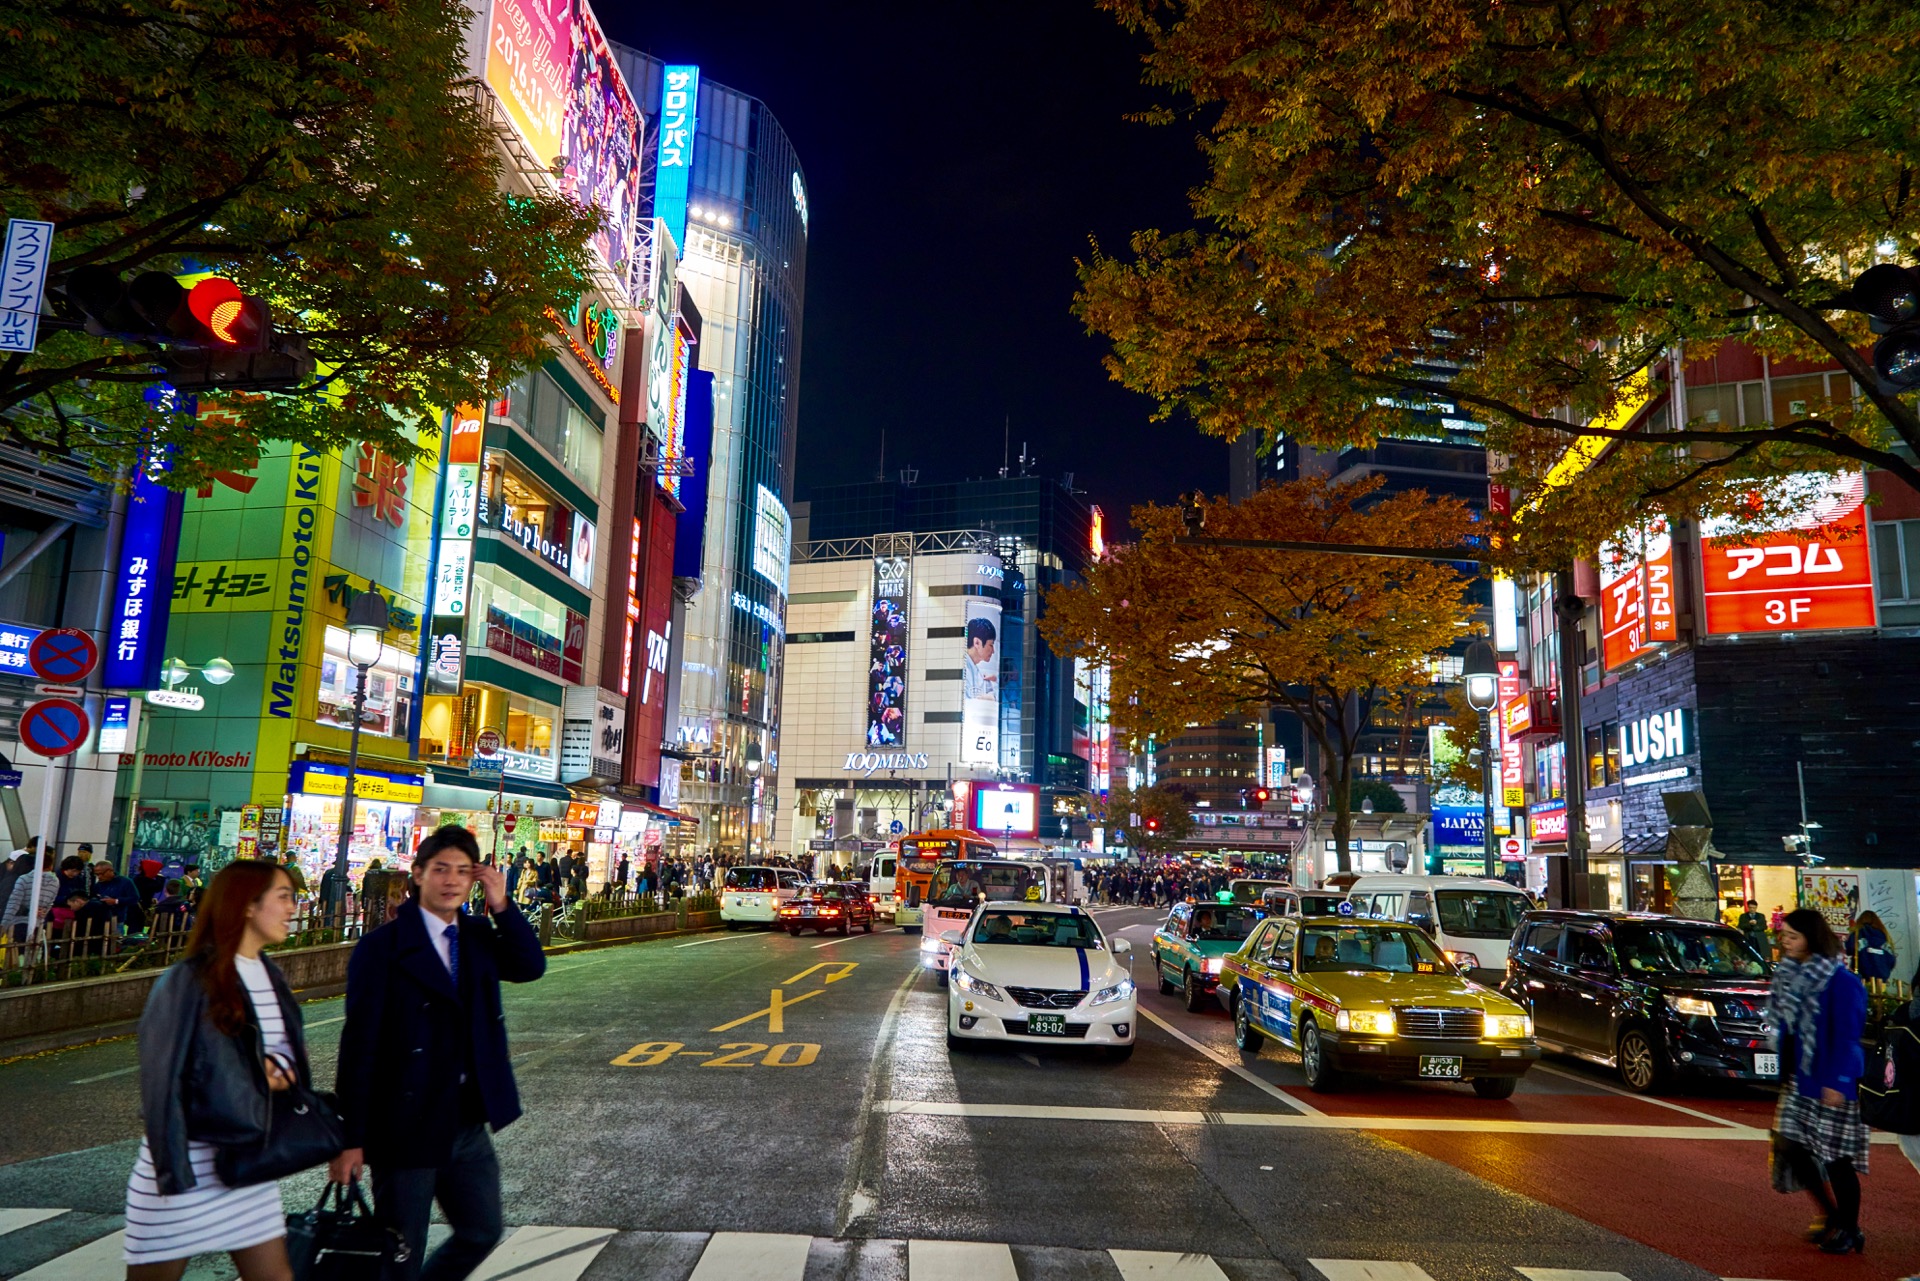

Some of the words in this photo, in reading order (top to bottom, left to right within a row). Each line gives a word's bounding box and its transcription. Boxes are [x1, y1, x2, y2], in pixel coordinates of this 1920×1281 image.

[495, 23, 557, 136] 2016.11.16
[661, 72, 689, 167] サロンパス
[1, 226, 40, 346] スクランブル式
[453, 419, 481, 434] JTB
[461, 480, 473, 517] フルーツ
[502, 504, 568, 568] Euphoria
[879, 562, 905, 579] EXO
[1726, 542, 1844, 580] アコム
[440, 564, 452, 602] フルーツ
[879, 583, 904, 597] XMAS
[1649, 565, 1672, 615] アコム
[117, 557, 148, 661] みずほ銀行
[269, 508, 315, 719] Matsumoto
[1764, 597, 1812, 624] 3F
[1654, 621, 1670, 630] 3F
[0, 632, 30, 649] 銀行
[436, 634, 461, 675] HUB
[479, 738, 498, 750] 消火栓
[1620, 708, 1684, 767] LUSH
[188, 750, 251, 767] KiYoshi
[1506, 789, 1521, 804] 薬
[939, 910, 967, 919] 高圧ガス
[1292, 987, 1305, 999] TAXI
[1036, 1021, 1063, 1033] 89-02
[609, 1041, 822, 1067] 8-20
[1428, 1064, 1459, 1076] 56-68
